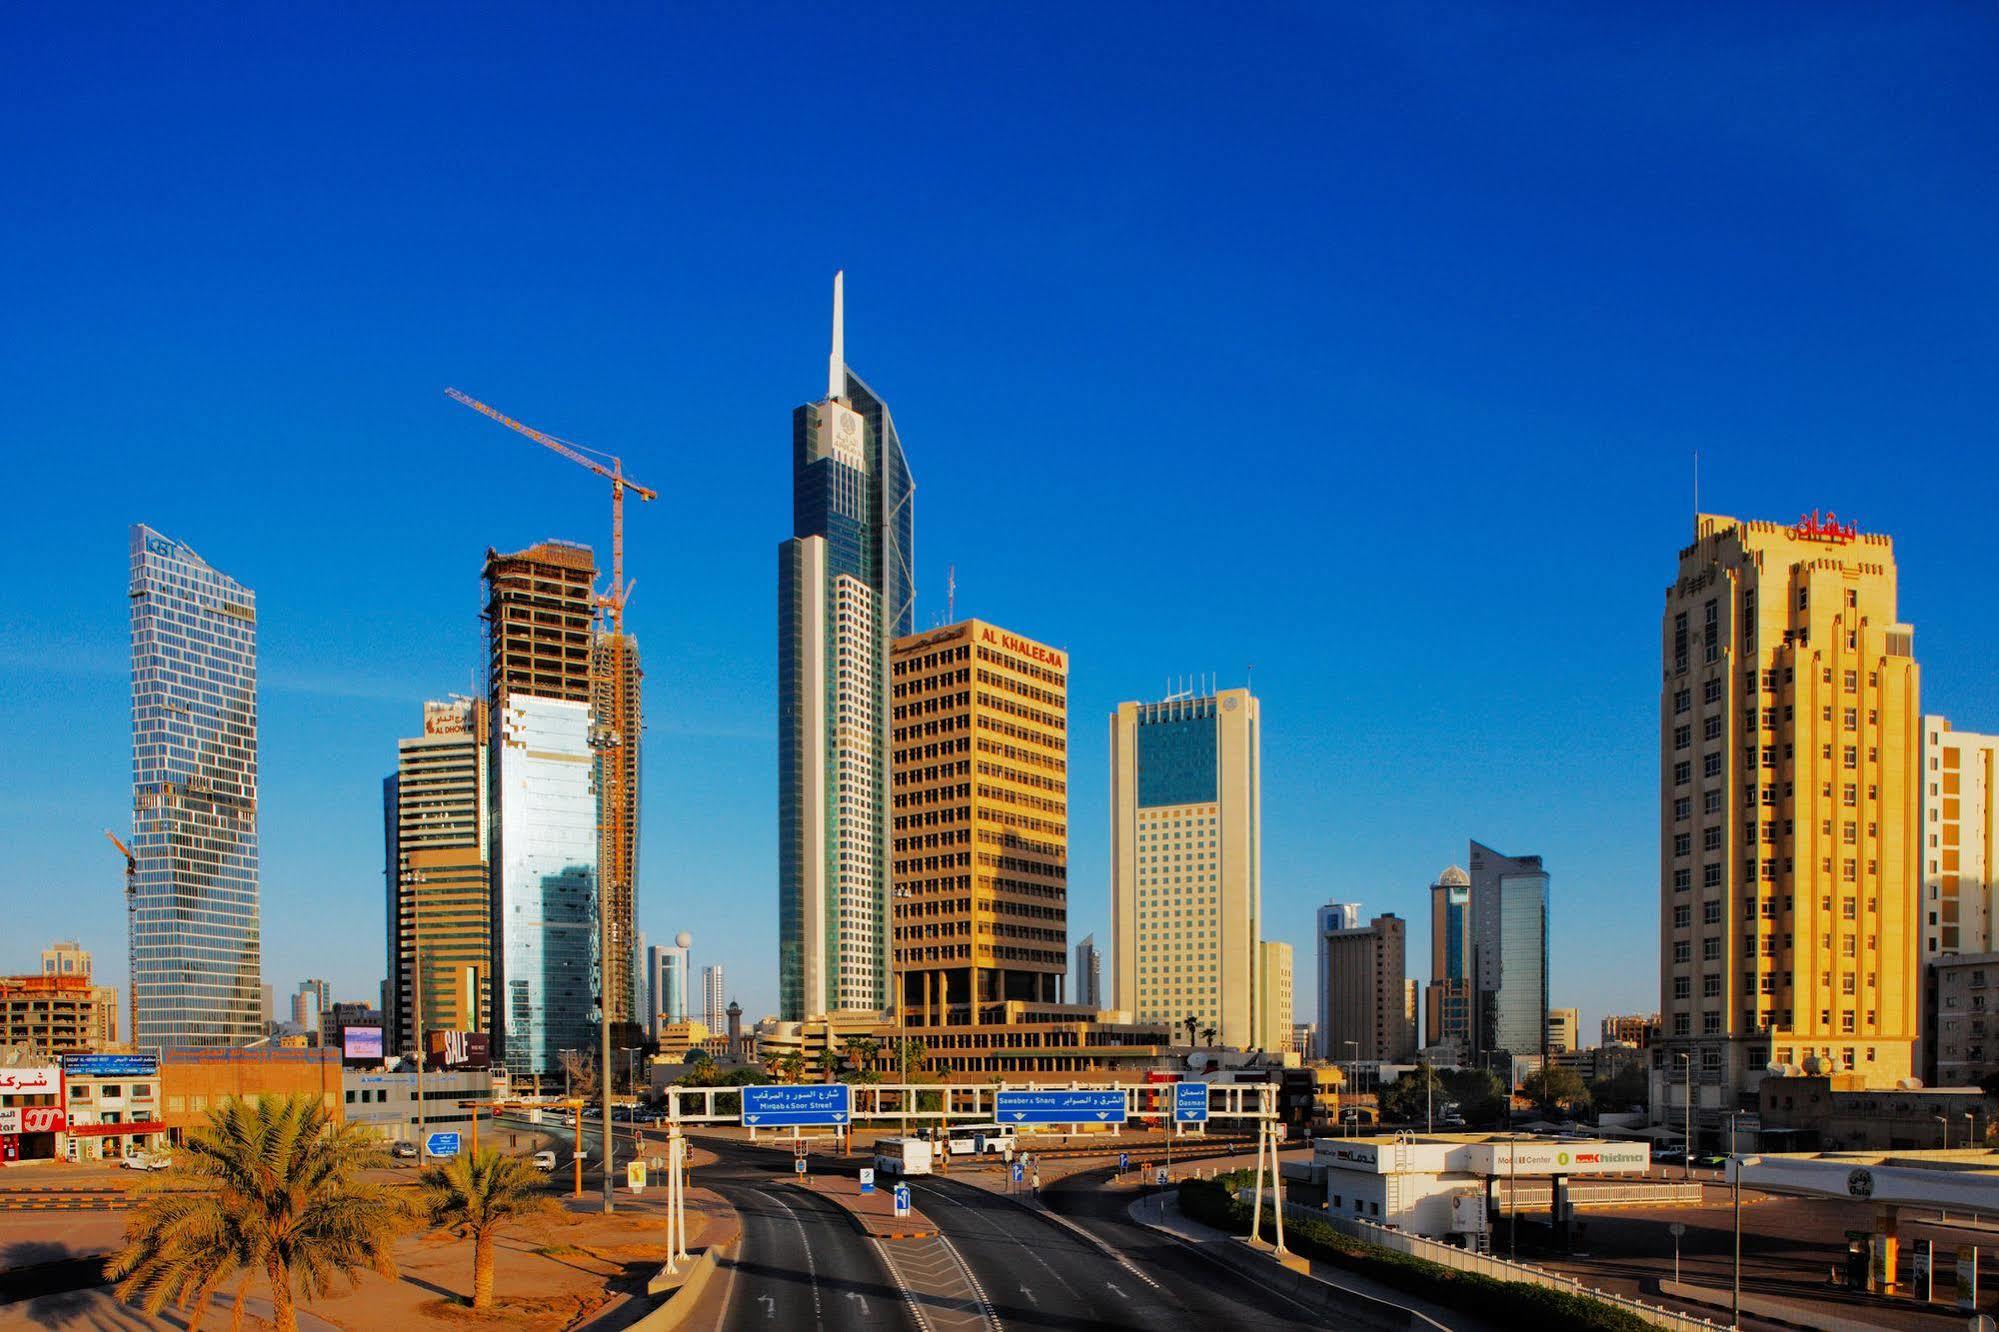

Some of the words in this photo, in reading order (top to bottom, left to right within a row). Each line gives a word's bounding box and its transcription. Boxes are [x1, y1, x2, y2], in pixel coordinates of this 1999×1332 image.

[982, 628, 997, 645] AL
[1002, 634, 1063, 669] KHALEEJIA
[445, 1029, 469, 1065] SALE
[793, 1090, 816, 1101] السور
[819, 1088, 840, 1100] شارع
[1180, 1089, 1205, 1097] دسمان
[1100, 1095, 1124, 1105] الشرق
[791, 1102, 808, 1110] Soor
[1527, 1156, 1551, 1164] Center
